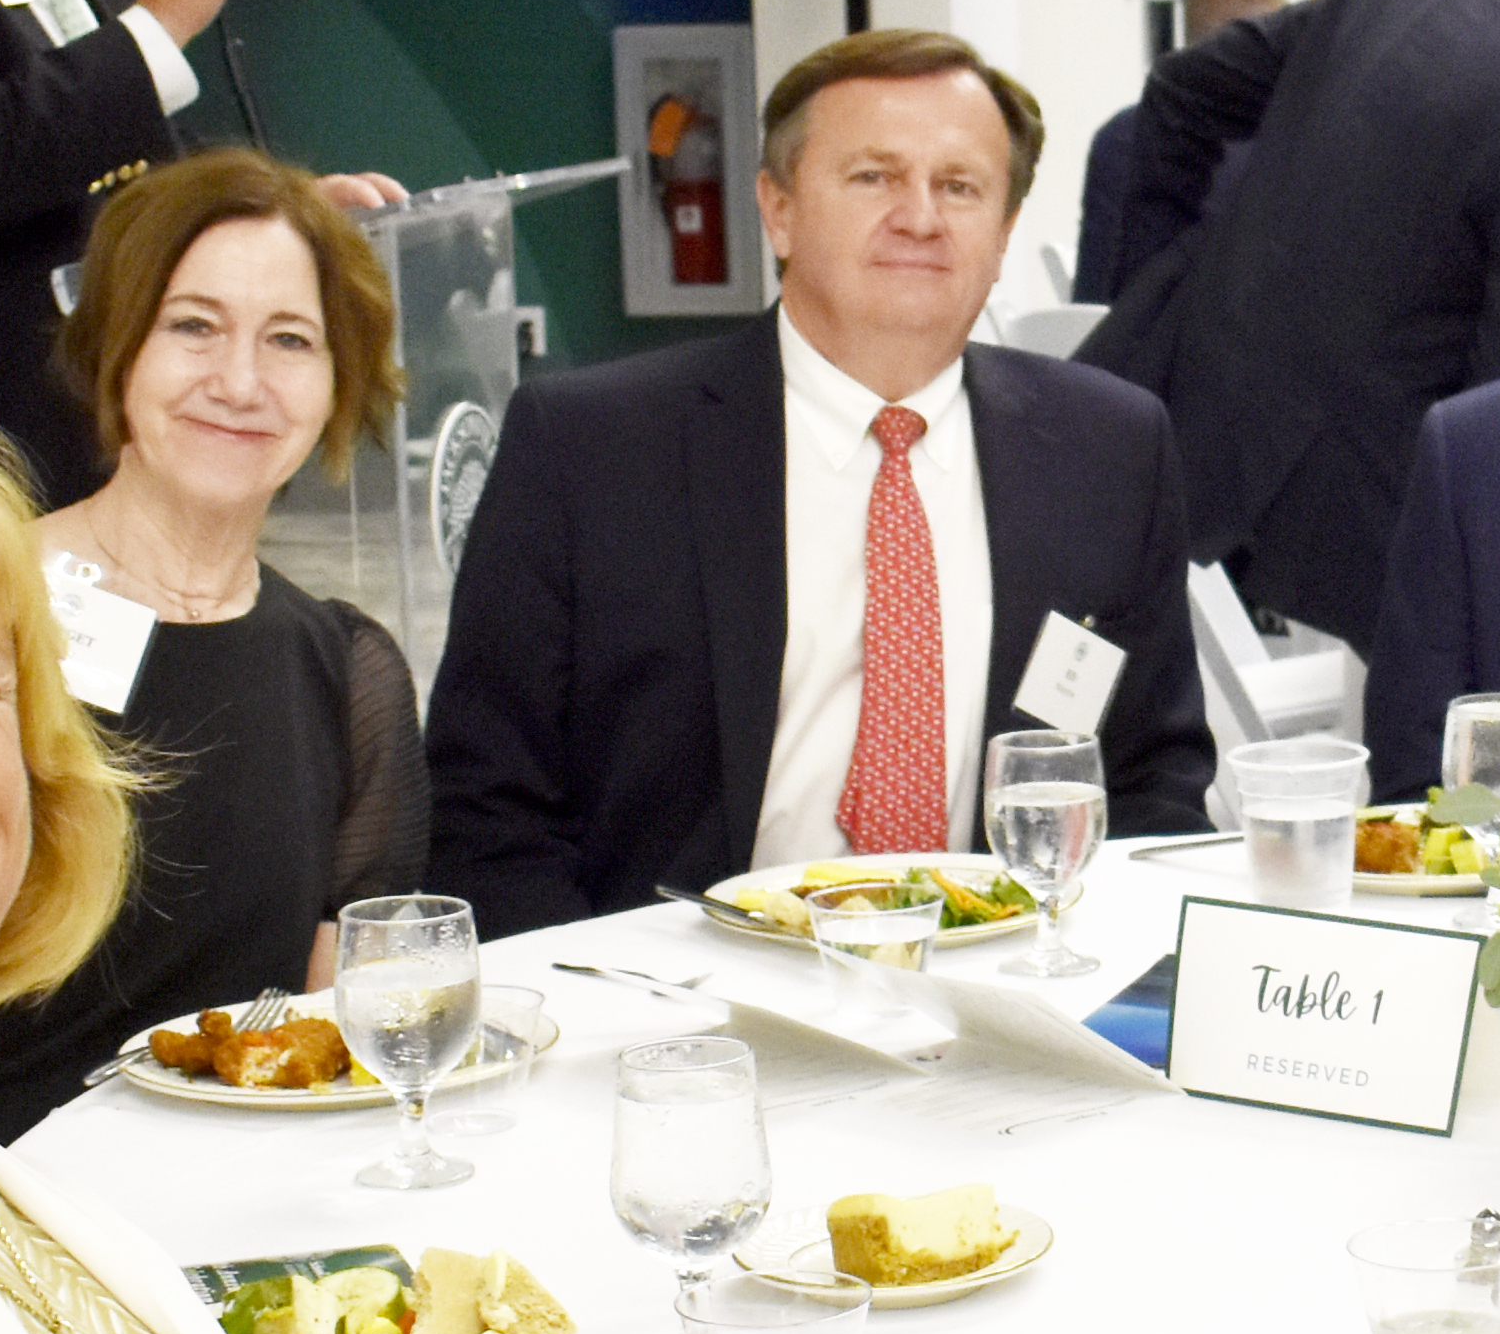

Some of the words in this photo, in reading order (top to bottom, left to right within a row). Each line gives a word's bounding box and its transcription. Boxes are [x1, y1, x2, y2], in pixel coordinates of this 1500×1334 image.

[1252, 965, 1357, 1020] Table
[1372, 990, 1384, 1025] 1
[1246, 1054, 1369, 1087] RESERVED
